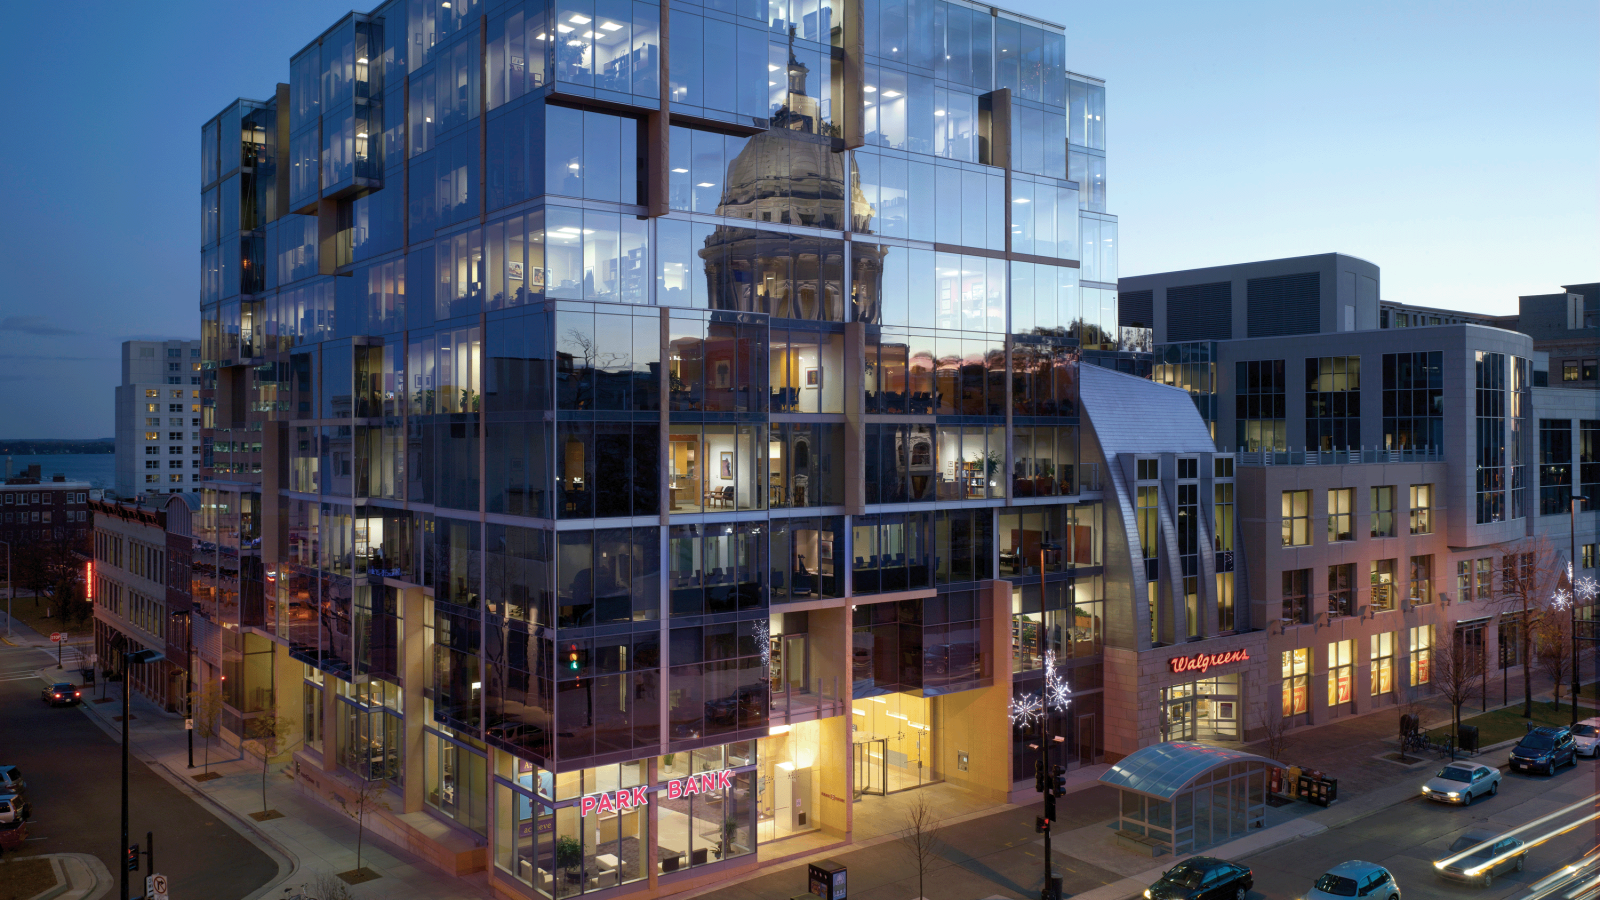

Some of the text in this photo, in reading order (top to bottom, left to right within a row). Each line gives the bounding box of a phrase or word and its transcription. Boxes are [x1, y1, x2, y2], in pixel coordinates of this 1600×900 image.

[1170, 648, 1250, 673] Walgreens
[581, 769, 732, 817] PARK BANK
[523, 822, 552, 834] aceve
